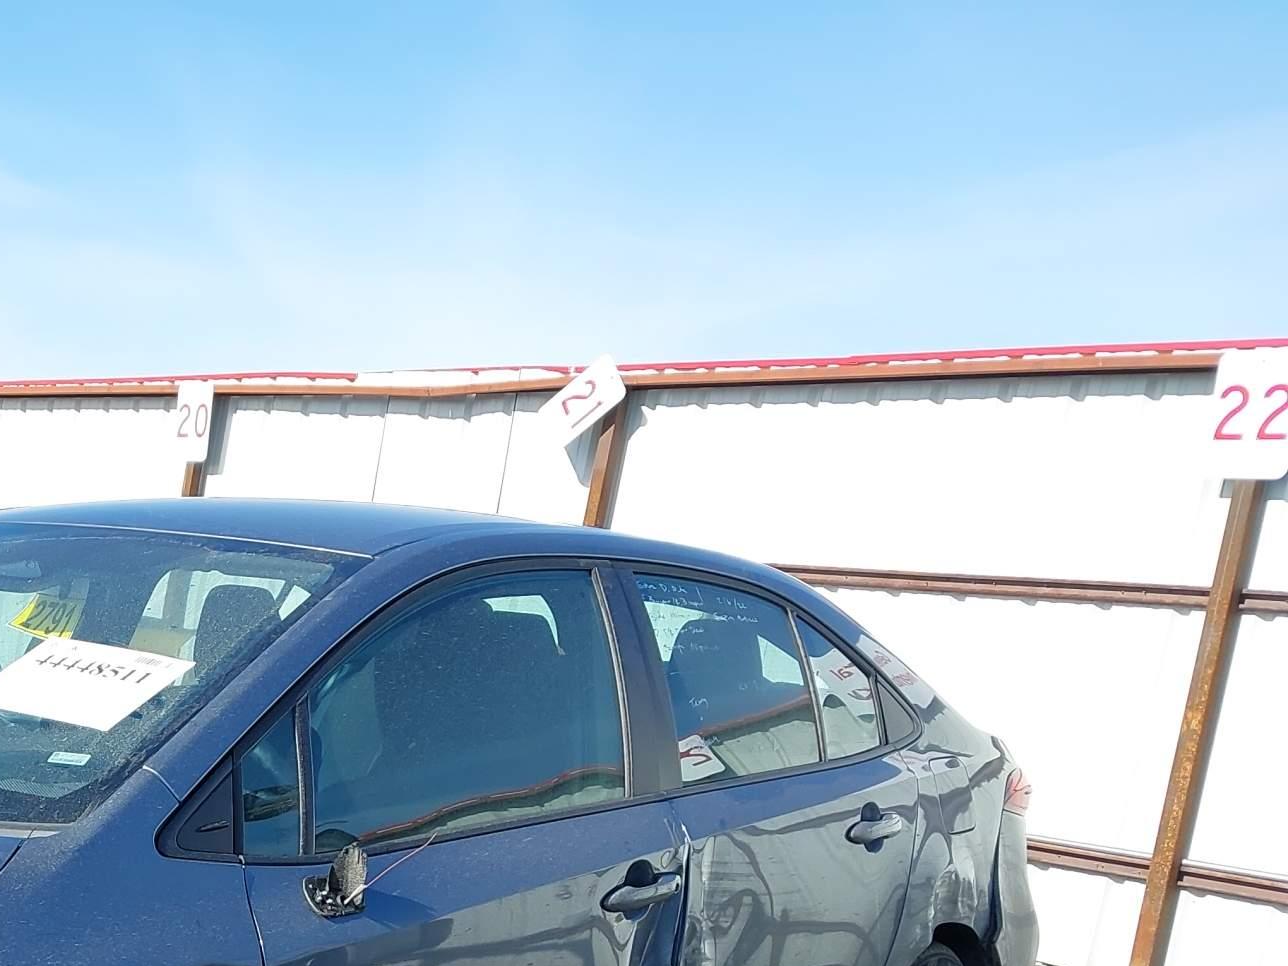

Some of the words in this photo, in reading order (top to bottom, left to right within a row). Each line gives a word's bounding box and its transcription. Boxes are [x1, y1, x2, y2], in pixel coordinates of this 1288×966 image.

[176, 403, 209, 438] 20
[561, 380, 603, 429] 21
[1213, 384, 1288, 440] 22
[24, 600, 78, 638] 2791
[35, 654, 152, 684] 44448511
